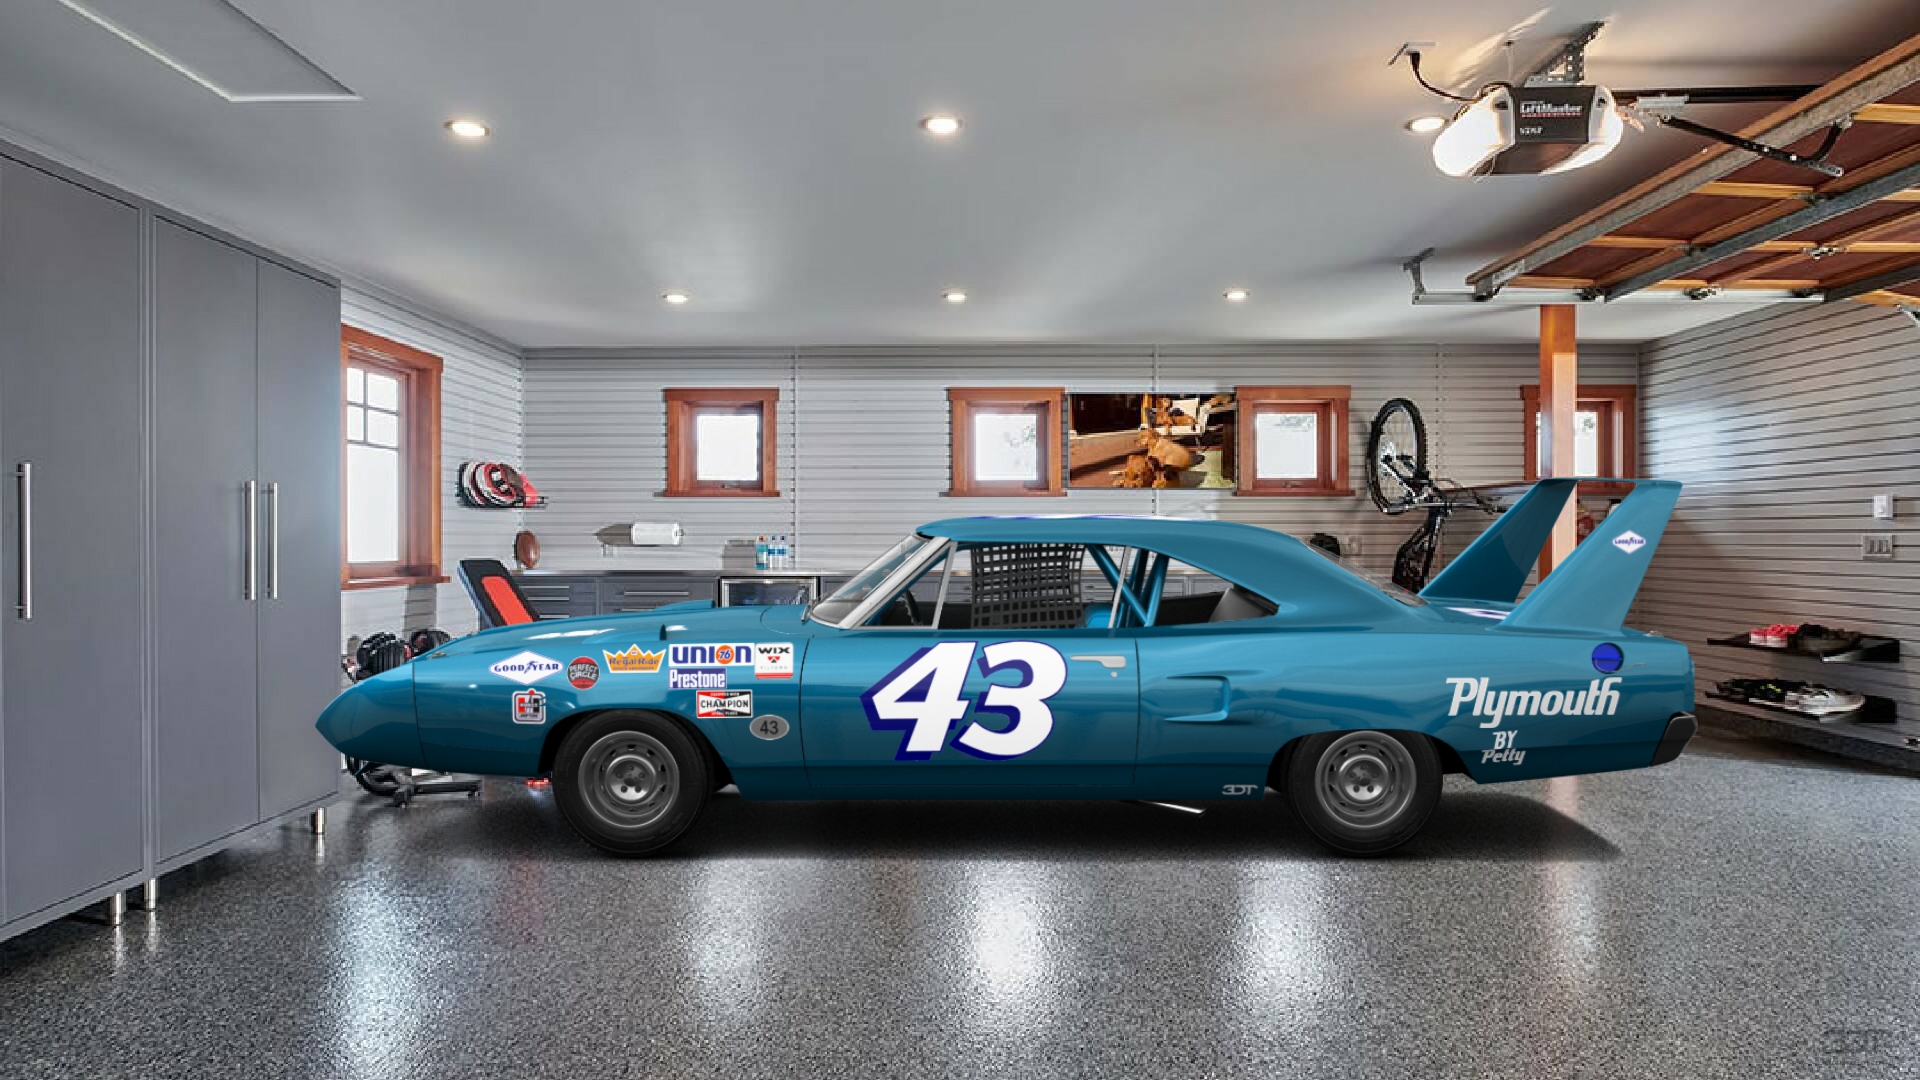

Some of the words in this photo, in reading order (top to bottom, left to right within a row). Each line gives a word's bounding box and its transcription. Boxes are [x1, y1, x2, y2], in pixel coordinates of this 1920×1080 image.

[717, 650, 731, 660] 76
[758, 647, 791, 655] WIX
[569, 663, 598, 673] PERFECT
[569, 671, 598, 681] CIRCLE
[669, 669, 726, 689] Prestone
[700, 699, 749, 708] CHAMPION
[859, 639, 1068, 761] 43
[1445, 677, 1622, 729] Plymouth
[760, 720, 779, 735] 43
[1492, 730, 1518, 750] BY
[1480, 749, 1526, 766] Petty
